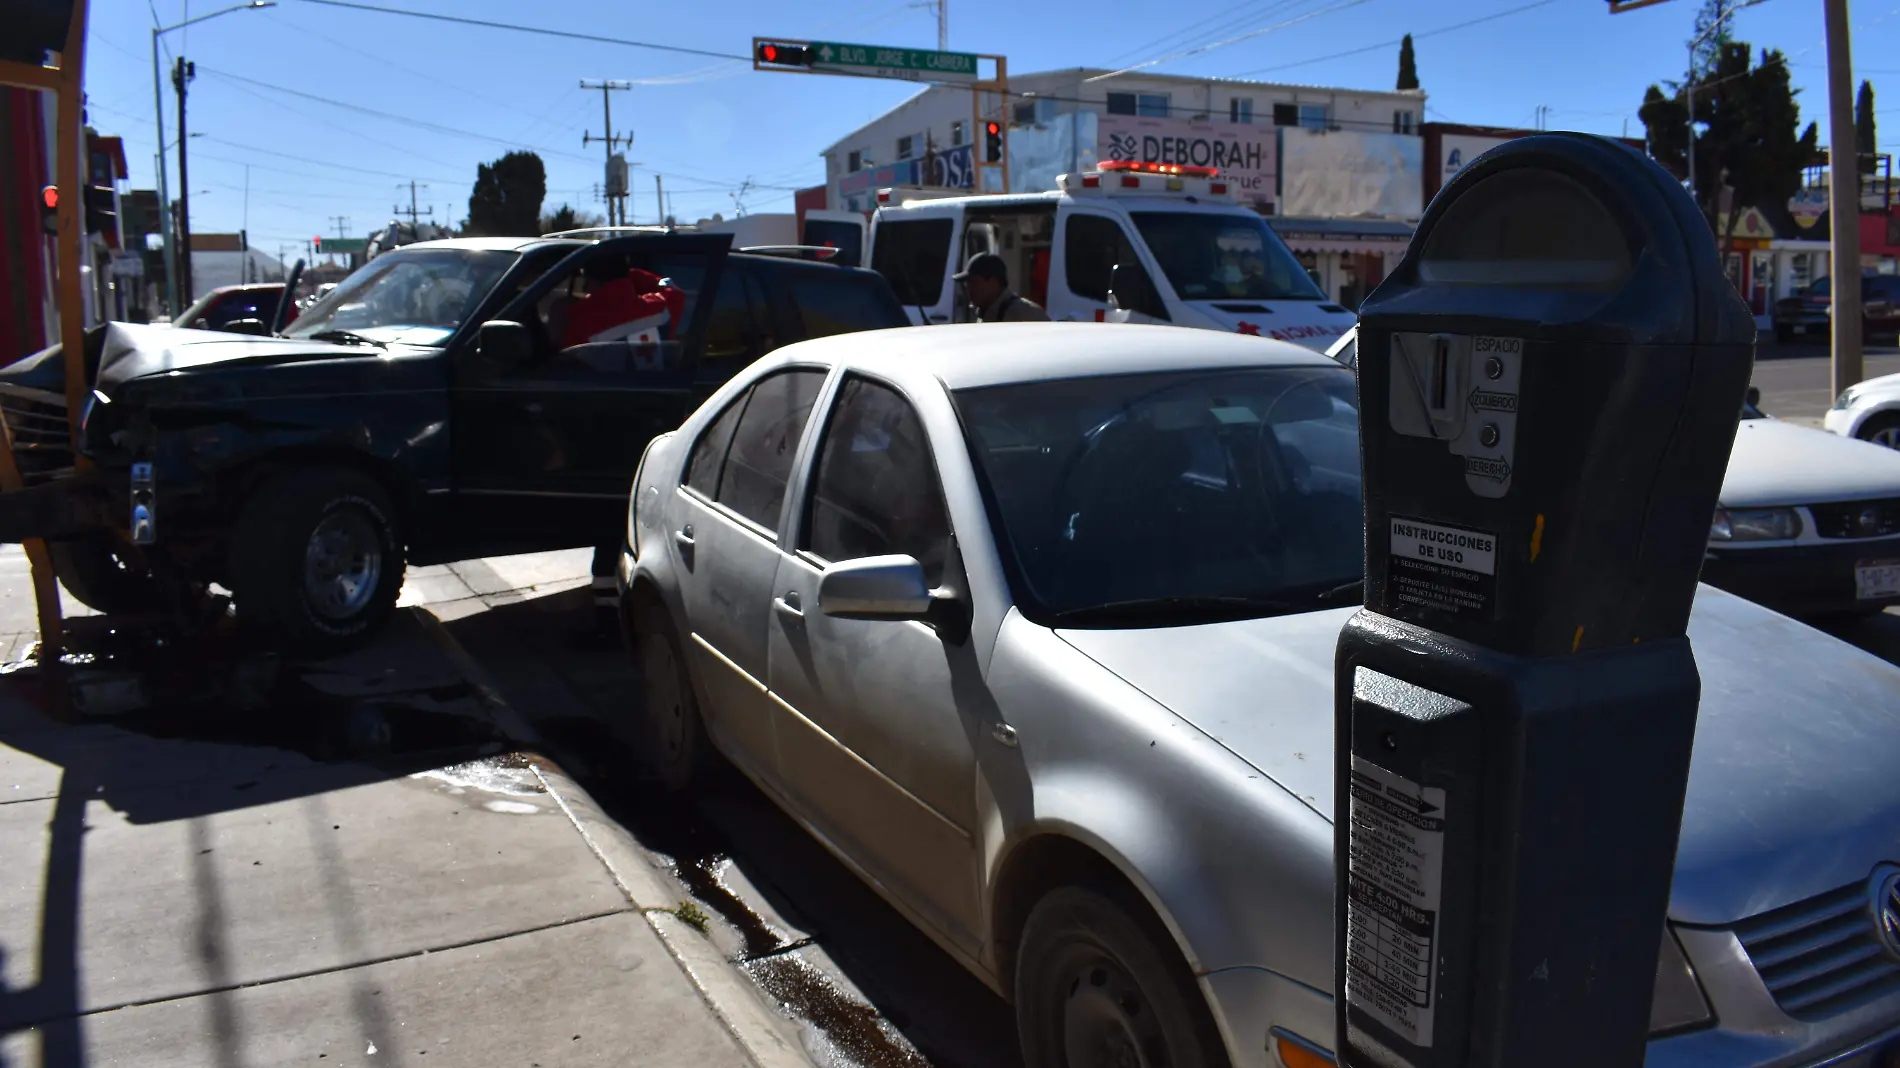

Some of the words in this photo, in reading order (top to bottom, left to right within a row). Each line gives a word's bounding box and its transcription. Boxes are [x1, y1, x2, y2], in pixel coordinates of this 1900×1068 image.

[874, 50, 904, 66] JORGE
[926, 54, 970, 71] CABRERA
[1143, 136, 1261, 170] DEBORAH
[1476, 337, 1520, 354] ESPACIO
[1466, 459, 1510, 475] DERECHO
[1394, 524, 1492, 552] INSTRUCCIONES
[1418, 545, 1434, 558] DE
[1438, 548, 1463, 564] USO
[1375, 891, 1398, 911] 4:00
[1402, 904, 1430, 925] HRS.
